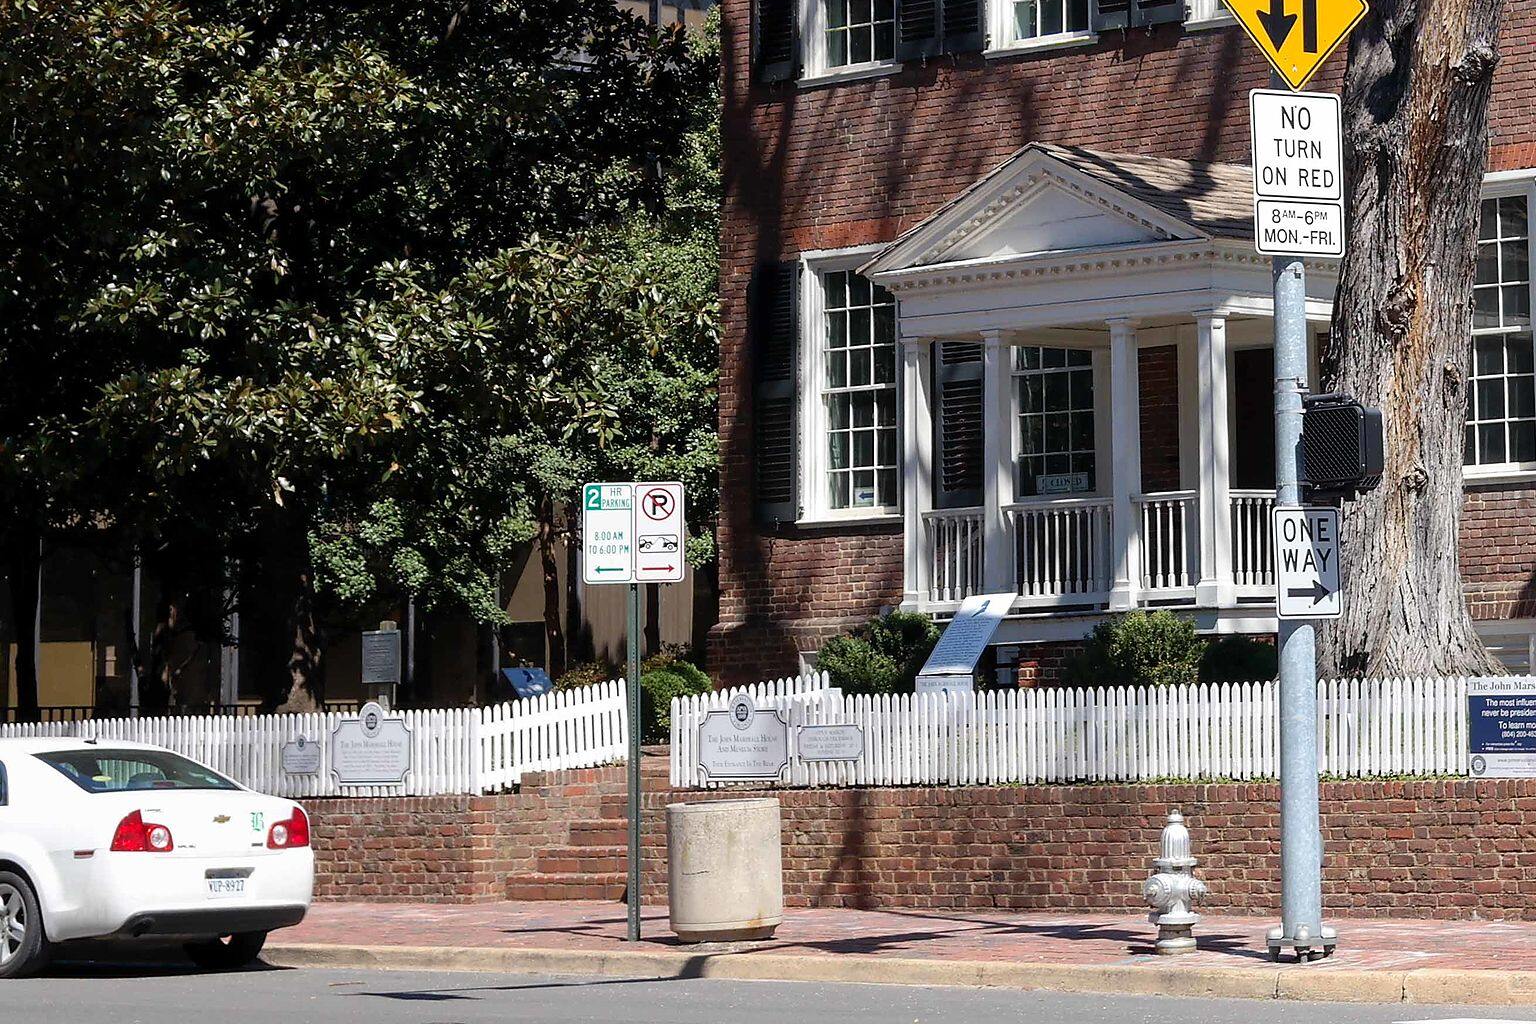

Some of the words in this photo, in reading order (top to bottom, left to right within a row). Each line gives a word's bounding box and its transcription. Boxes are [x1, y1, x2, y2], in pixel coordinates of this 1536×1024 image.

[1280, 106, 1311, 131] NO
[1273, 138, 1322, 160] TURN
[1262, 166, 1287, 186] ON
[1298, 168, 1334, 189] RED
[587, 488, 600, 508] 2
[609, 487, 622, 497] HR
[602, 498, 630, 508] PARKING
[613, 531, 624, 540] AM
[1282, 518, 1331, 543] ONE
[589, 545, 597, 555] TO
[619, 545, 630, 555] PM
[1282, 548, 1332, 573] WAY
[1471, 681, 1488, 691] The
[1490, 681, 1511, 691] John
[1486, 699, 1498, 707] The
[1499, 699, 1515, 707] most
[1481, 709, 1500, 717] never
[1500, 708, 1509, 717] be
[1498, 721, 1507, 729] To
[1508, 721, 1525, 729] learn
